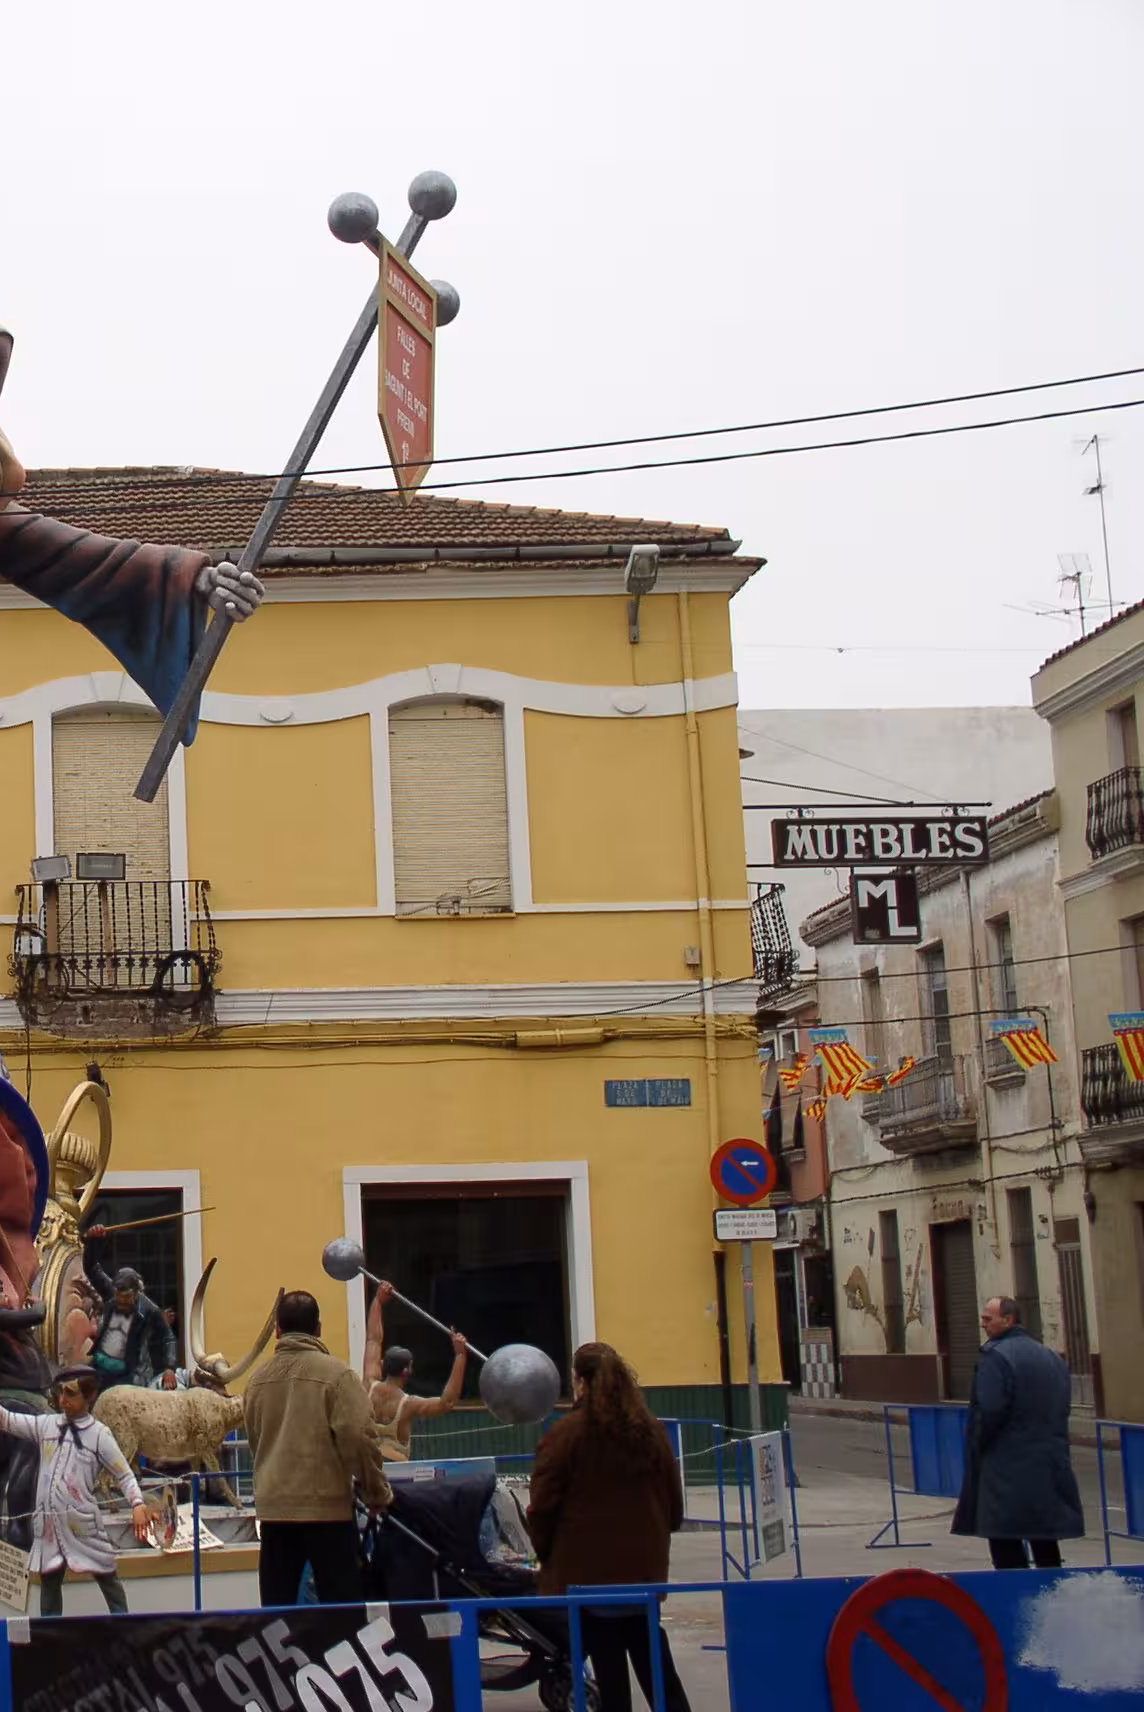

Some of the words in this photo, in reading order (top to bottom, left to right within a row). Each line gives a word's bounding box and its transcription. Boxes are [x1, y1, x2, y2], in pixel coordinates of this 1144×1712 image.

[388, 270, 407, 300] JUNTA
[408, 288, 427, 320] LOCAL
[397, 325, 416, 357] FALLES
[402, 358, 411, 380] DE
[397, 408, 415, 438] PREMI
[783, 822, 984, 860] MUEBLES
[215, 1618, 312, 1711] 975
